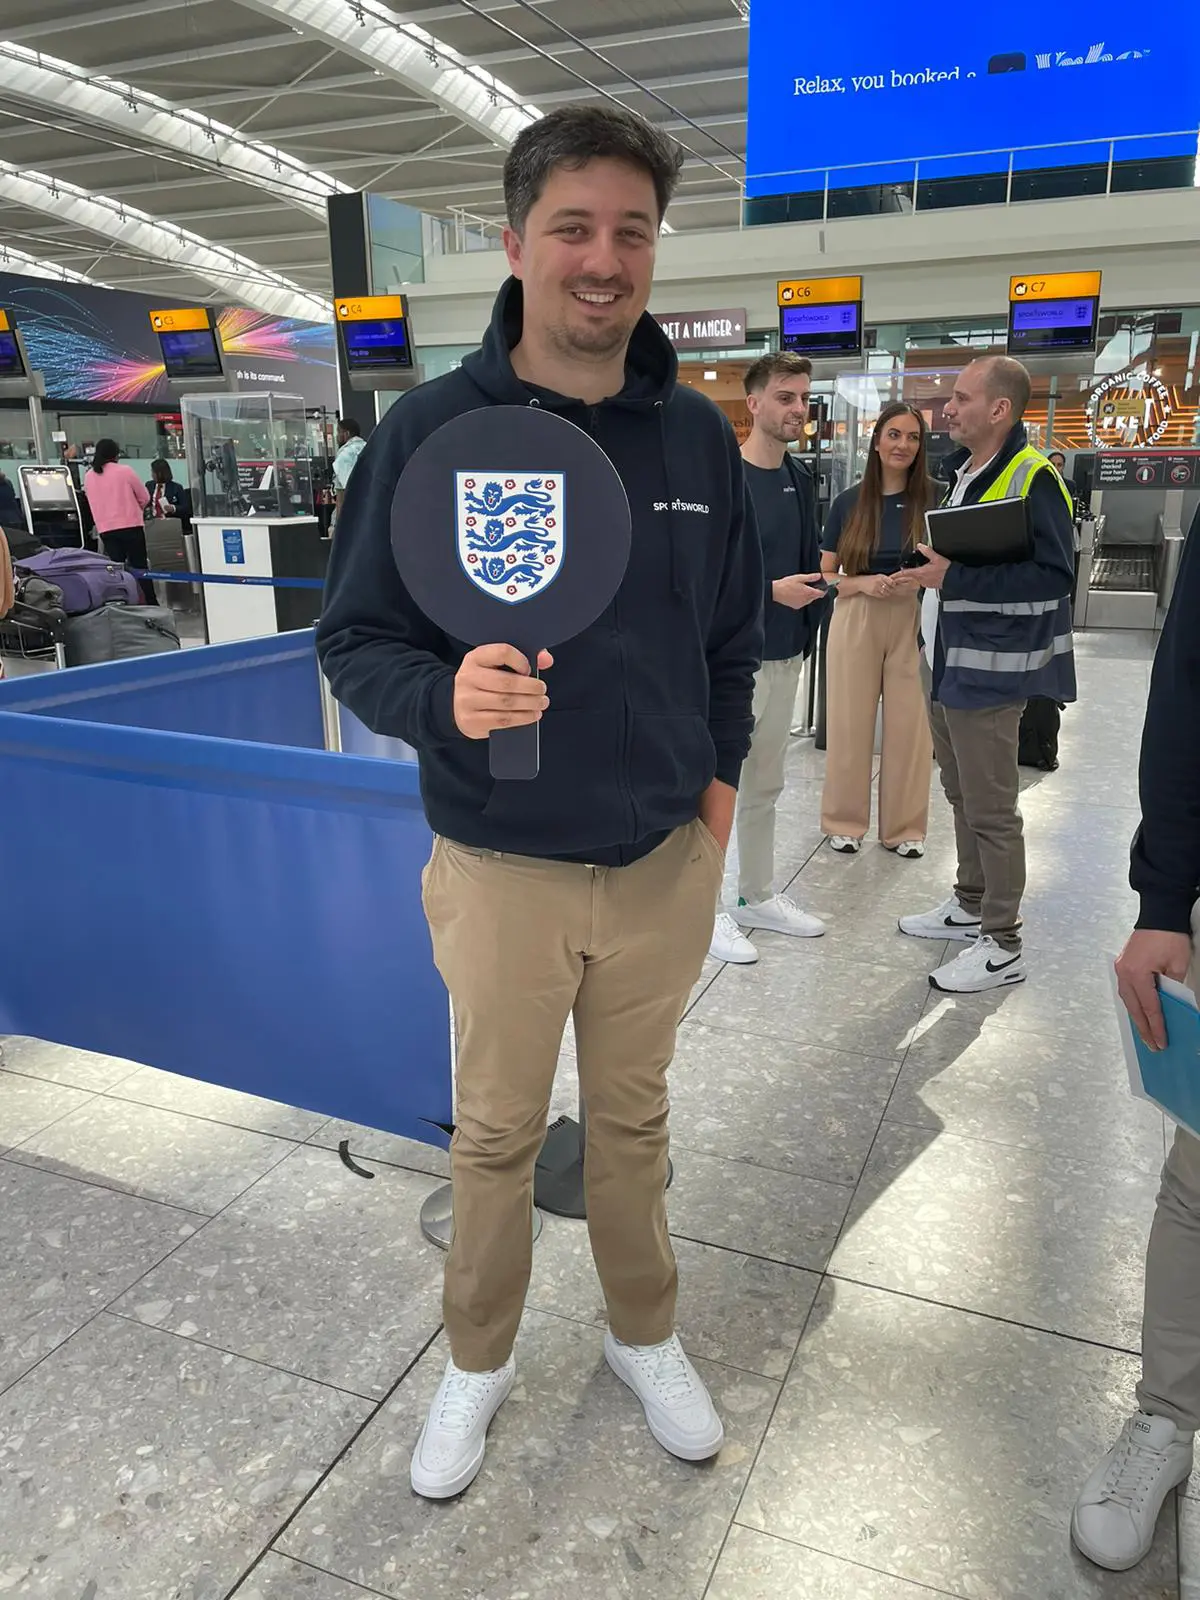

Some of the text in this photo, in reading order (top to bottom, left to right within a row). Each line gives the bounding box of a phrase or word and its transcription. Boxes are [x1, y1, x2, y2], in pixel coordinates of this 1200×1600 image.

[793, 66, 960, 96] Relax, you booked
[796, 287, 811, 298] C6
[1030, 282, 1046, 292] C7
[351, 304, 362, 314] C4
[164, 316, 174, 325] C3
[682, 322, 690, 339] A
[693, 319, 733, 338] MANGER
[1090, 370, 1169, 402] ORGANIC COFFEE
